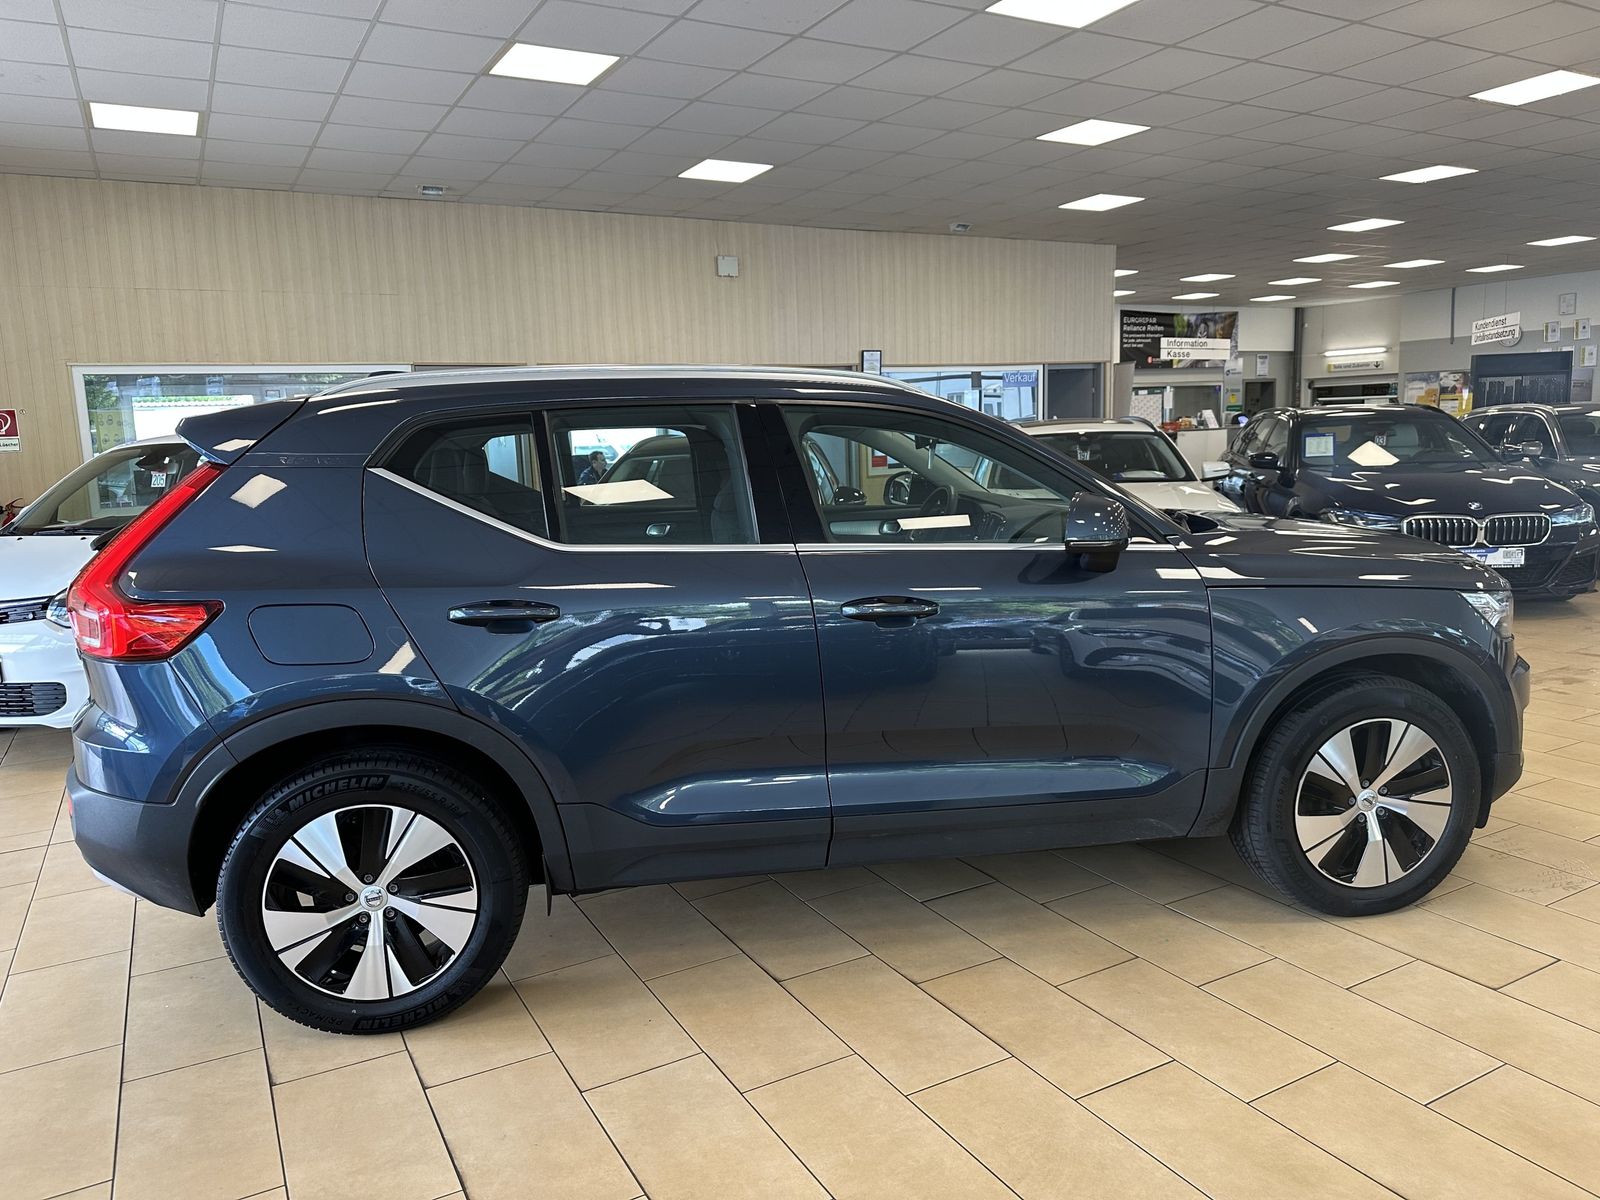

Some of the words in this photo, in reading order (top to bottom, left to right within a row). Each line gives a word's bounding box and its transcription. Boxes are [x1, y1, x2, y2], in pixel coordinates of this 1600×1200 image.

[1475, 317, 1507, 331] Kundendienst
[1166, 339, 1208, 348] Information
[1166, 350, 1191, 358] Kasse
[1003, 371, 1036, 383] Verkauf
[152, 474, 165, 487] 205
[287, 776, 385, 811] MICHELIN
